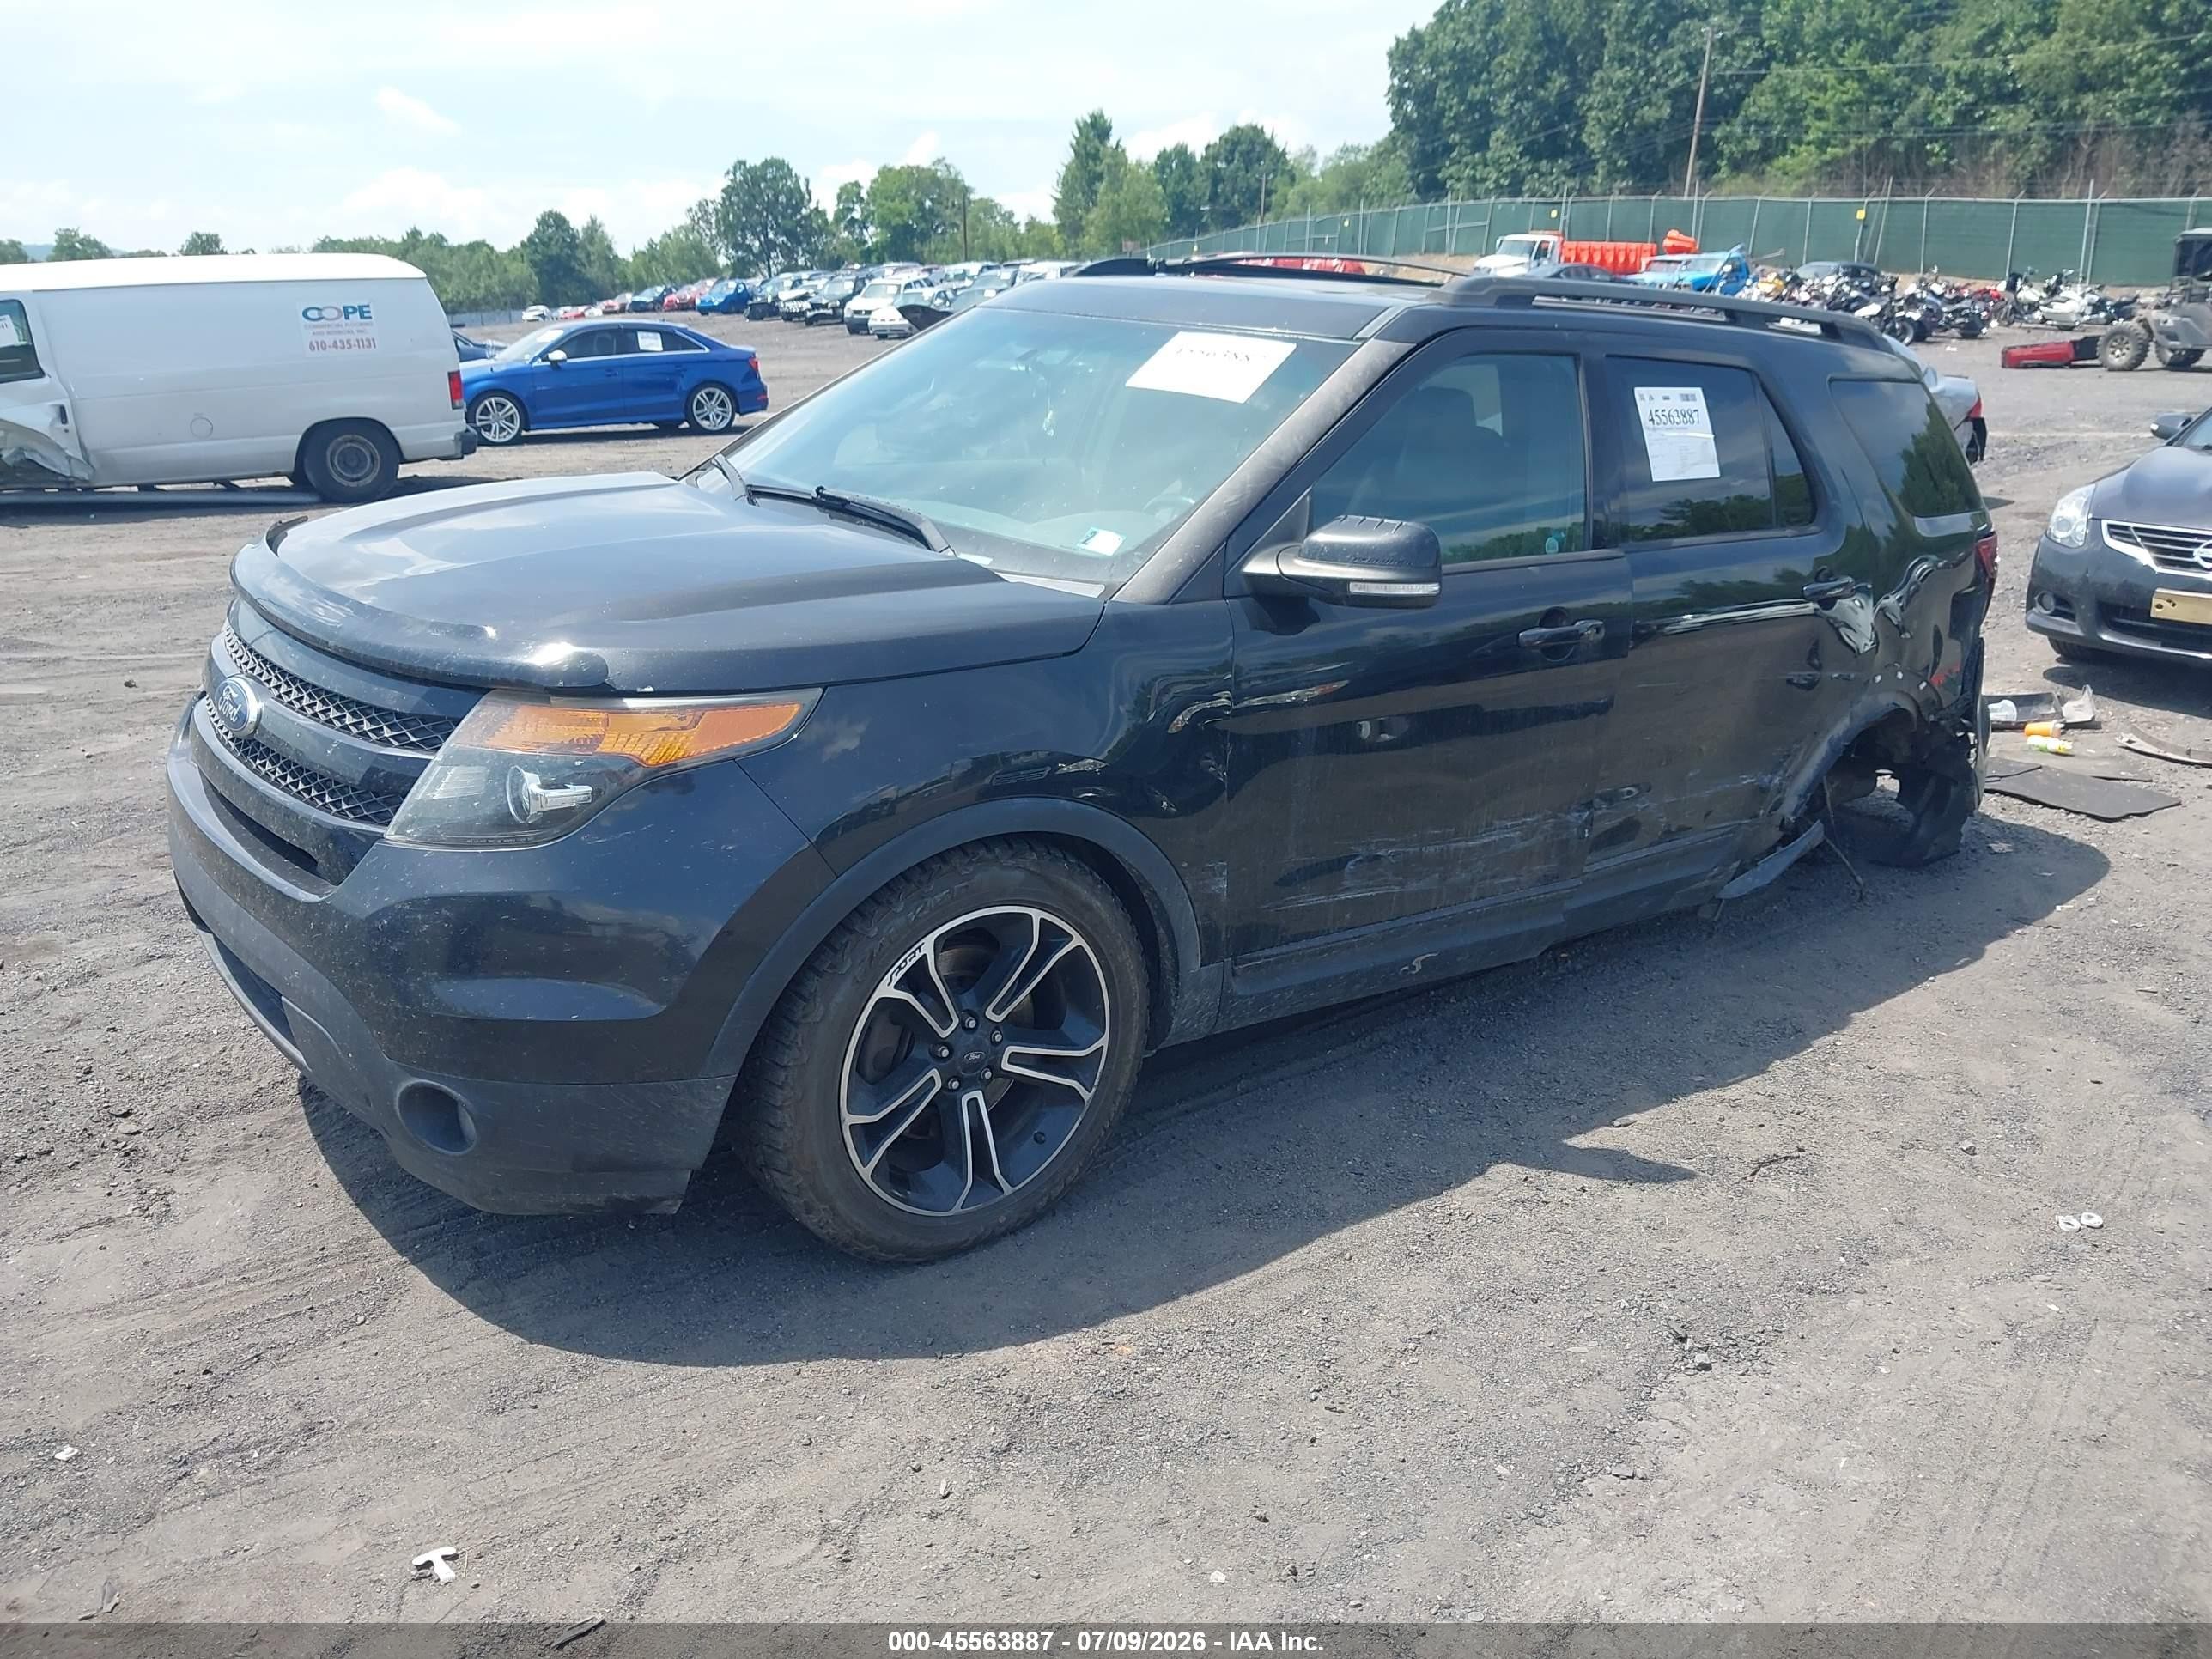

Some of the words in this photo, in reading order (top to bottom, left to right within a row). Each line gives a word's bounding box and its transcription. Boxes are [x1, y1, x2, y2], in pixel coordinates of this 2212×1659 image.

[302, 304, 373, 321] COPE
[309, 337, 376, 351] 610-435-1131
[1648, 409, 1700, 426] 45563887
[218, 685, 242, 722] Ford
